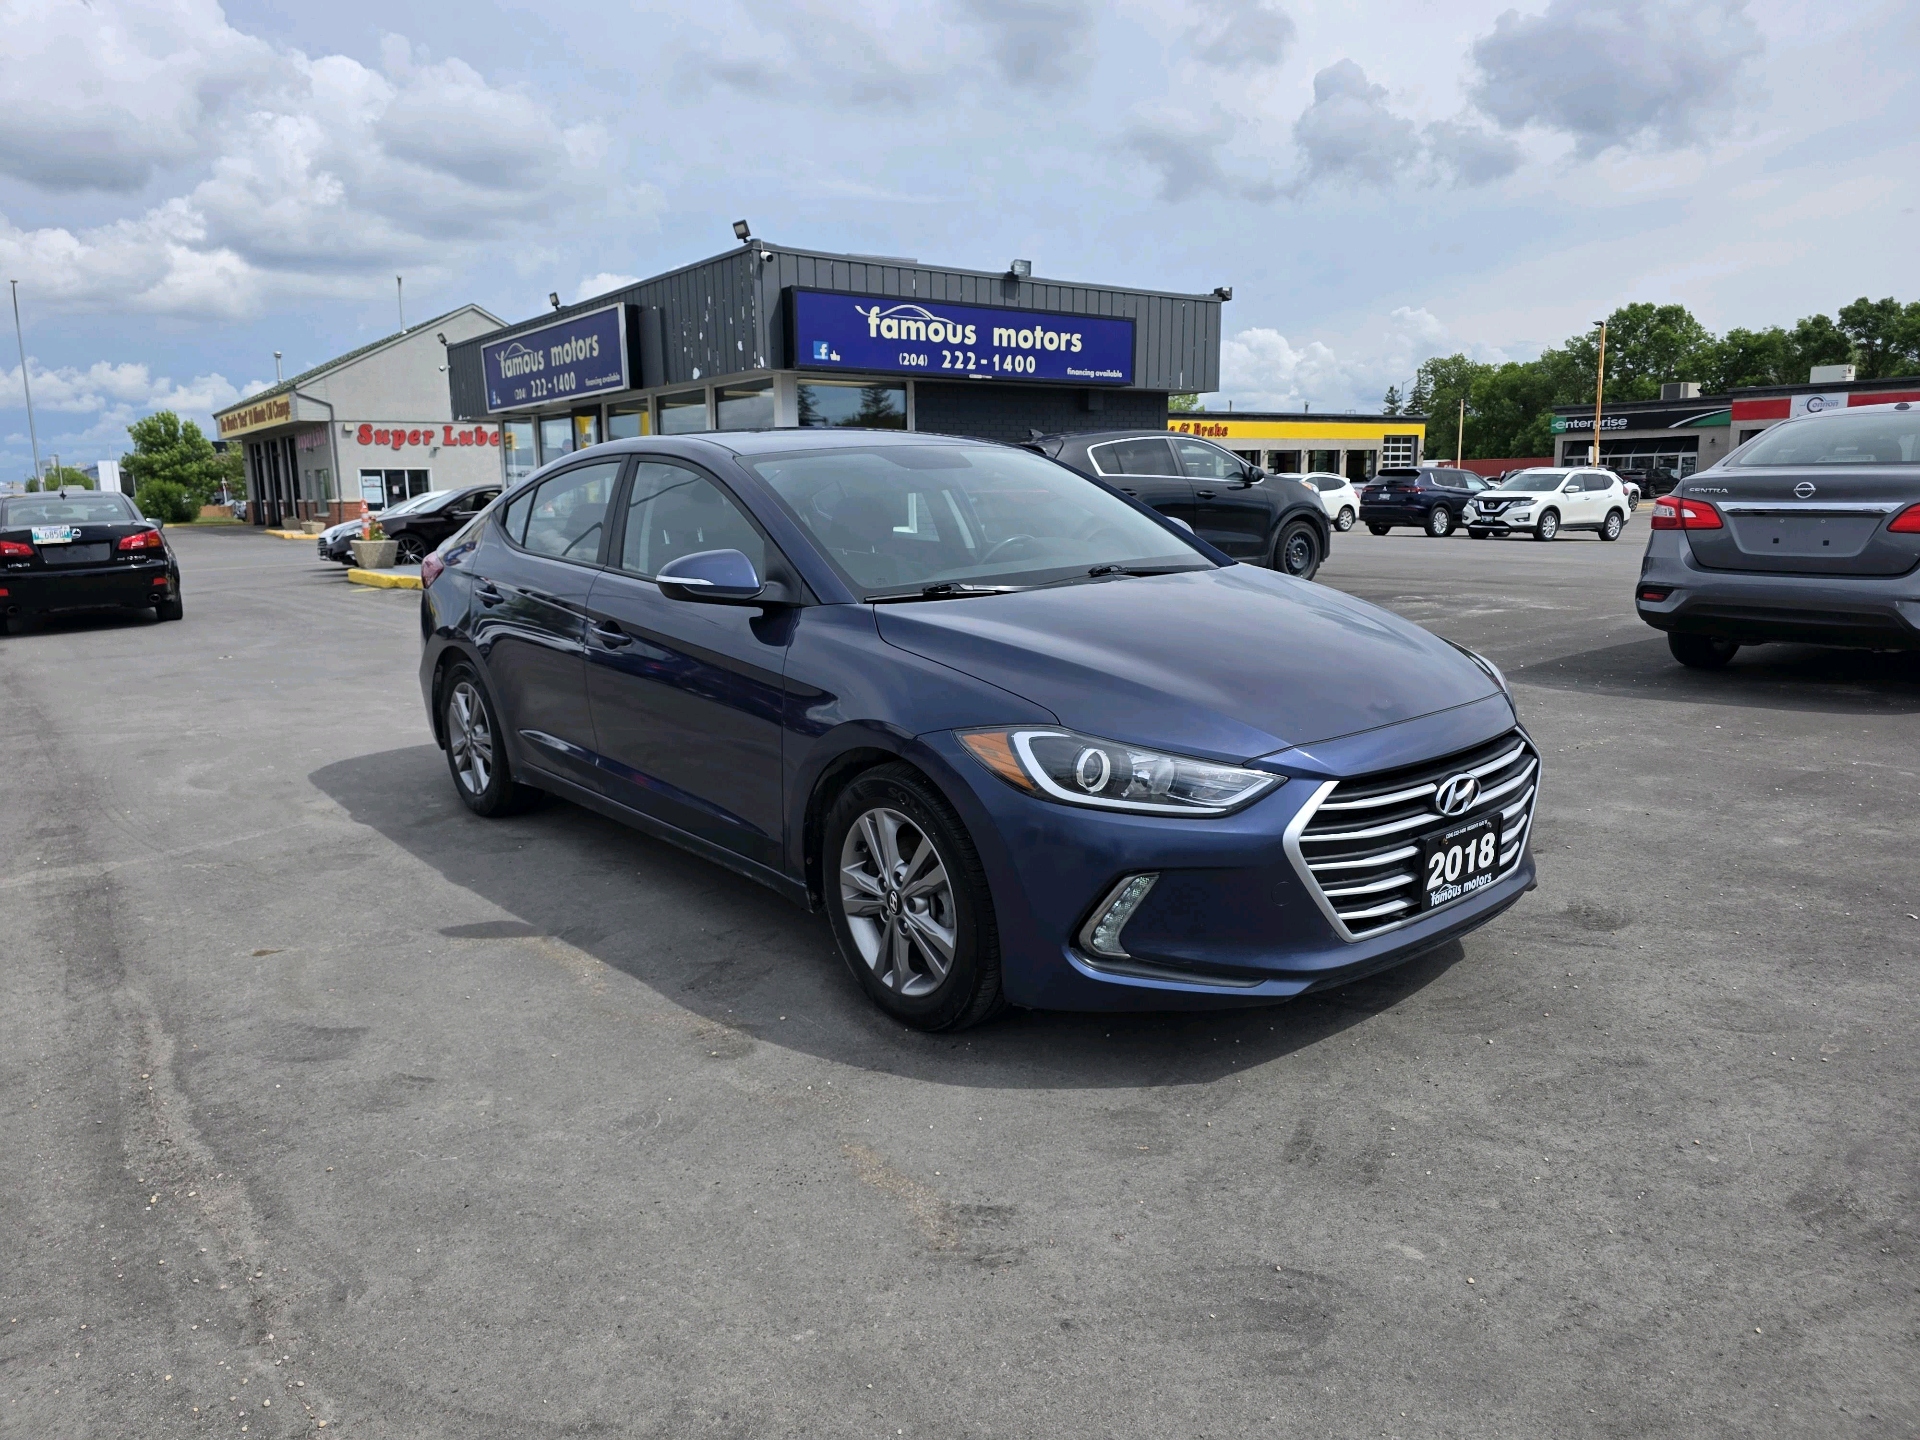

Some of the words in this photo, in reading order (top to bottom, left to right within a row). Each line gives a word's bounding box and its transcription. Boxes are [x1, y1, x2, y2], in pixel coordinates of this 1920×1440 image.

[868, 306, 977, 345] famous
[993, 326, 1082, 352] motors
[500, 350, 544, 379] famous
[551, 334, 599, 367] motors
[899, 352, 928, 366] (204)
[1067, 367, 1094, 379] financing
[1095, 368, 1123, 378] available
[357, 423, 435, 450] Super
[442, 425, 500, 447] Lube
[1193, 423, 1229, 437] Brake
[1553, 417, 1628, 430] enterprise
[1427, 832, 1495, 891] 2018
[1430, 884, 1461, 907] famous
[1463, 873, 1492, 893] motors
